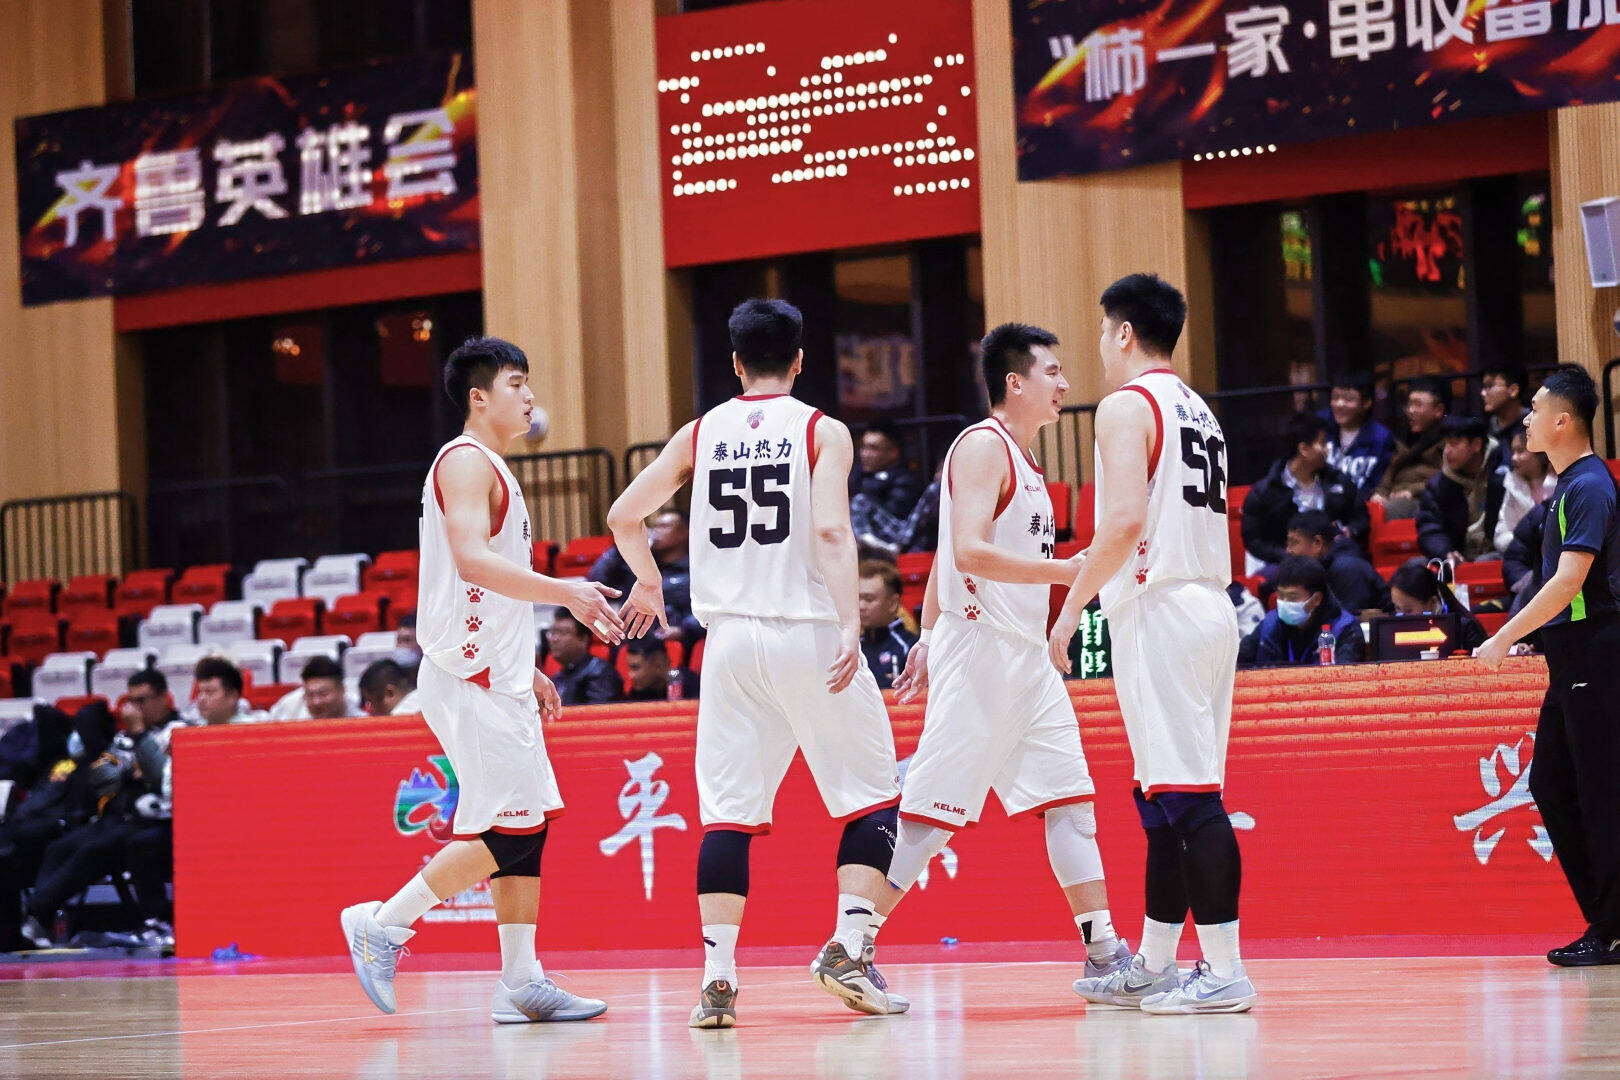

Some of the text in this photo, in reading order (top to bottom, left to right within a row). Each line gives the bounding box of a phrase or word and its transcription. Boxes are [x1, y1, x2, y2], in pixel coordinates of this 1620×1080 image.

[55, 106, 459, 249] 齐鲁英雄会
[712, 437, 792, 461] 泰山热力
[708, 462, 791, 549] 55
[496, 809, 530, 818] KELME
[932, 801, 967, 816] KELME
